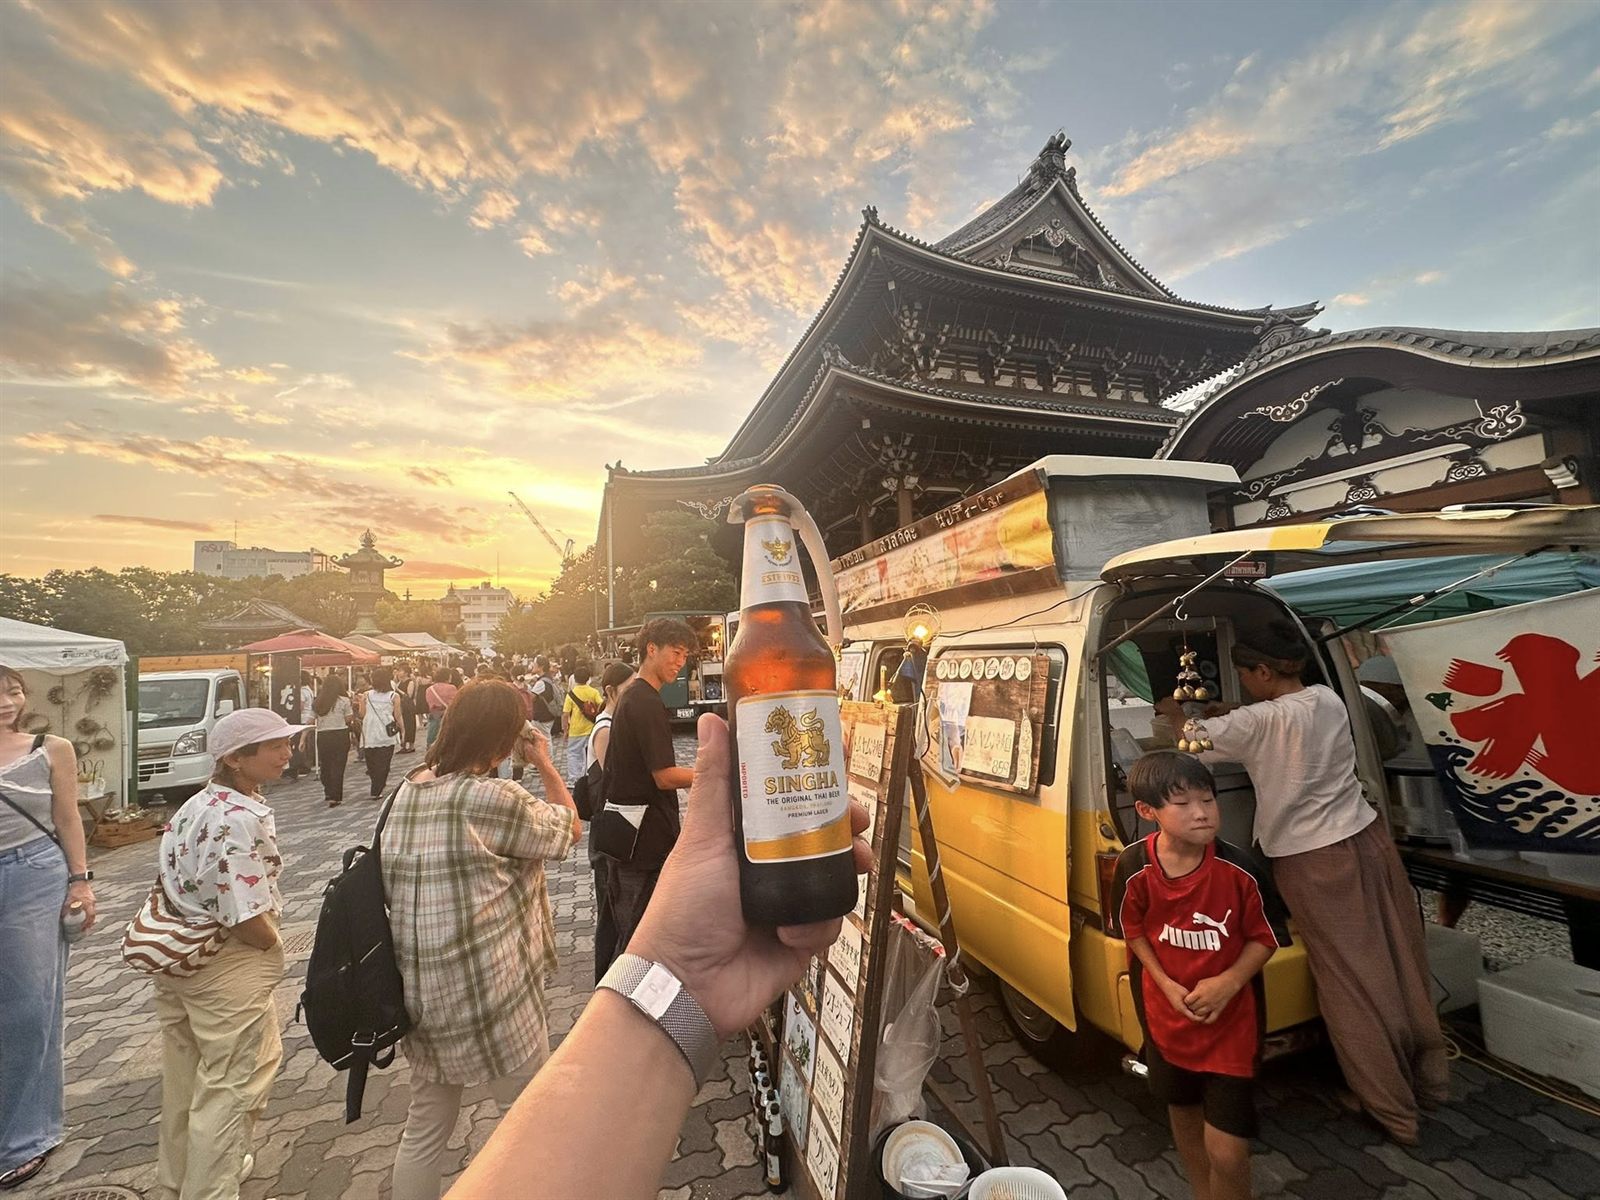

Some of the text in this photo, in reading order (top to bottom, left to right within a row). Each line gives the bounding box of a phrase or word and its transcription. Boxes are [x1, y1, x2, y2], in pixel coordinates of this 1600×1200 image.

[764, 771, 839, 795] SINGHA
[781, 795, 812, 804] ORIGINAL
[829, 790, 840, 799] BEER
[788, 810, 813, 818] PREMIUM
